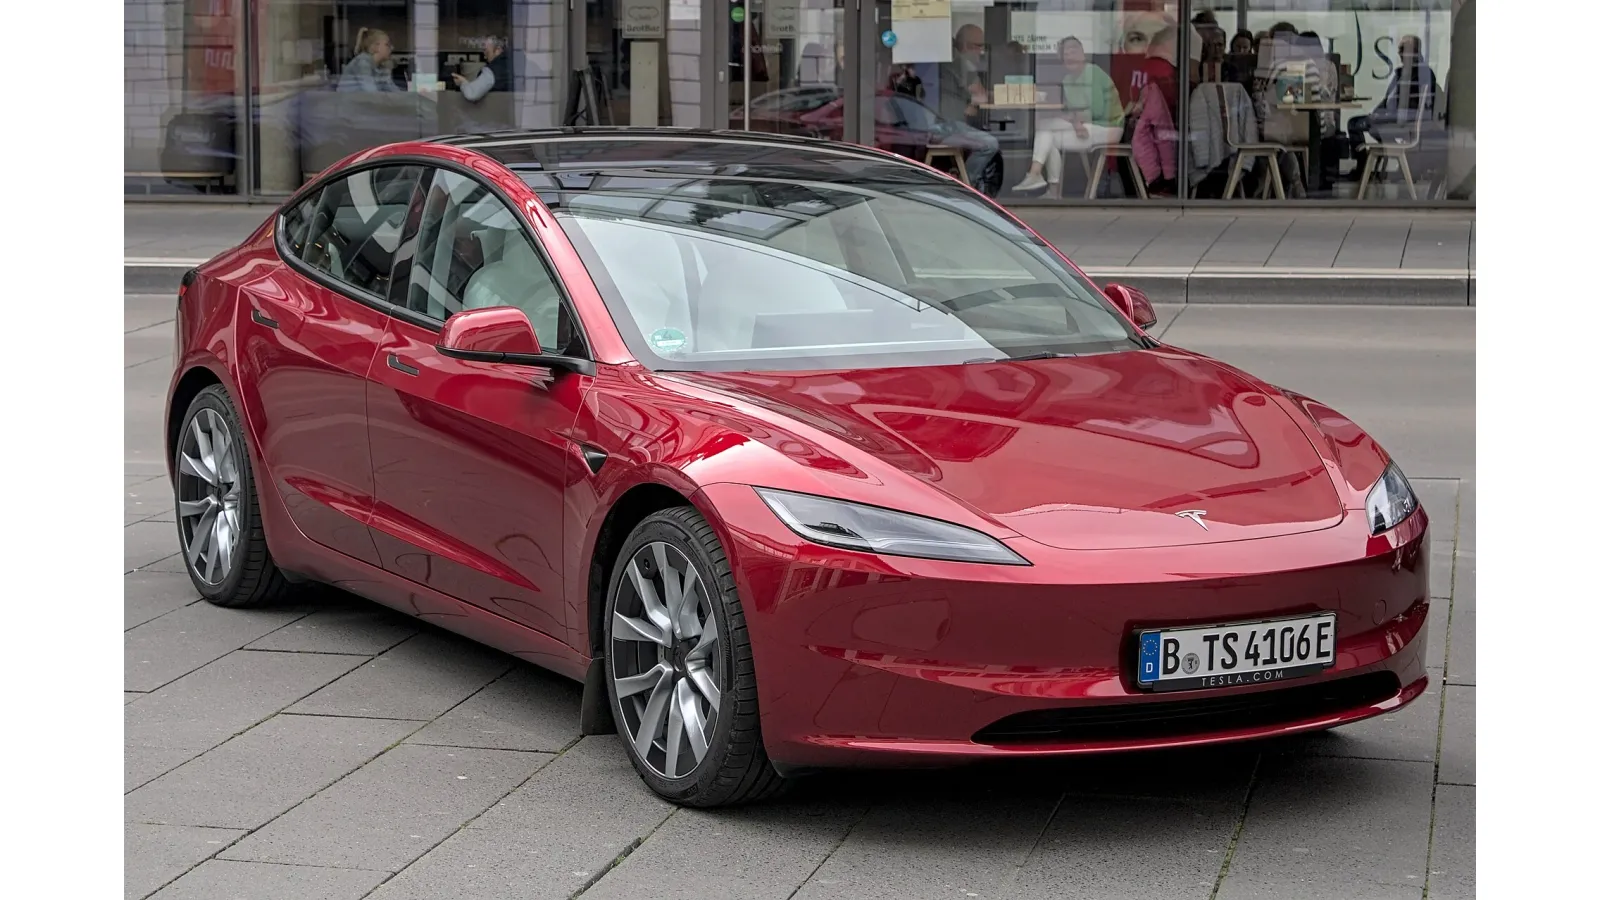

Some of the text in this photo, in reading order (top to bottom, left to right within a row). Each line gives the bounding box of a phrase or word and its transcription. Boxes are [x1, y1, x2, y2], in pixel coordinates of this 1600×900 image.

[1163, 639, 1180, 675] B
[1146, 663, 1153, 673] D
[1202, 670, 1283, 687] TESLA.COM
